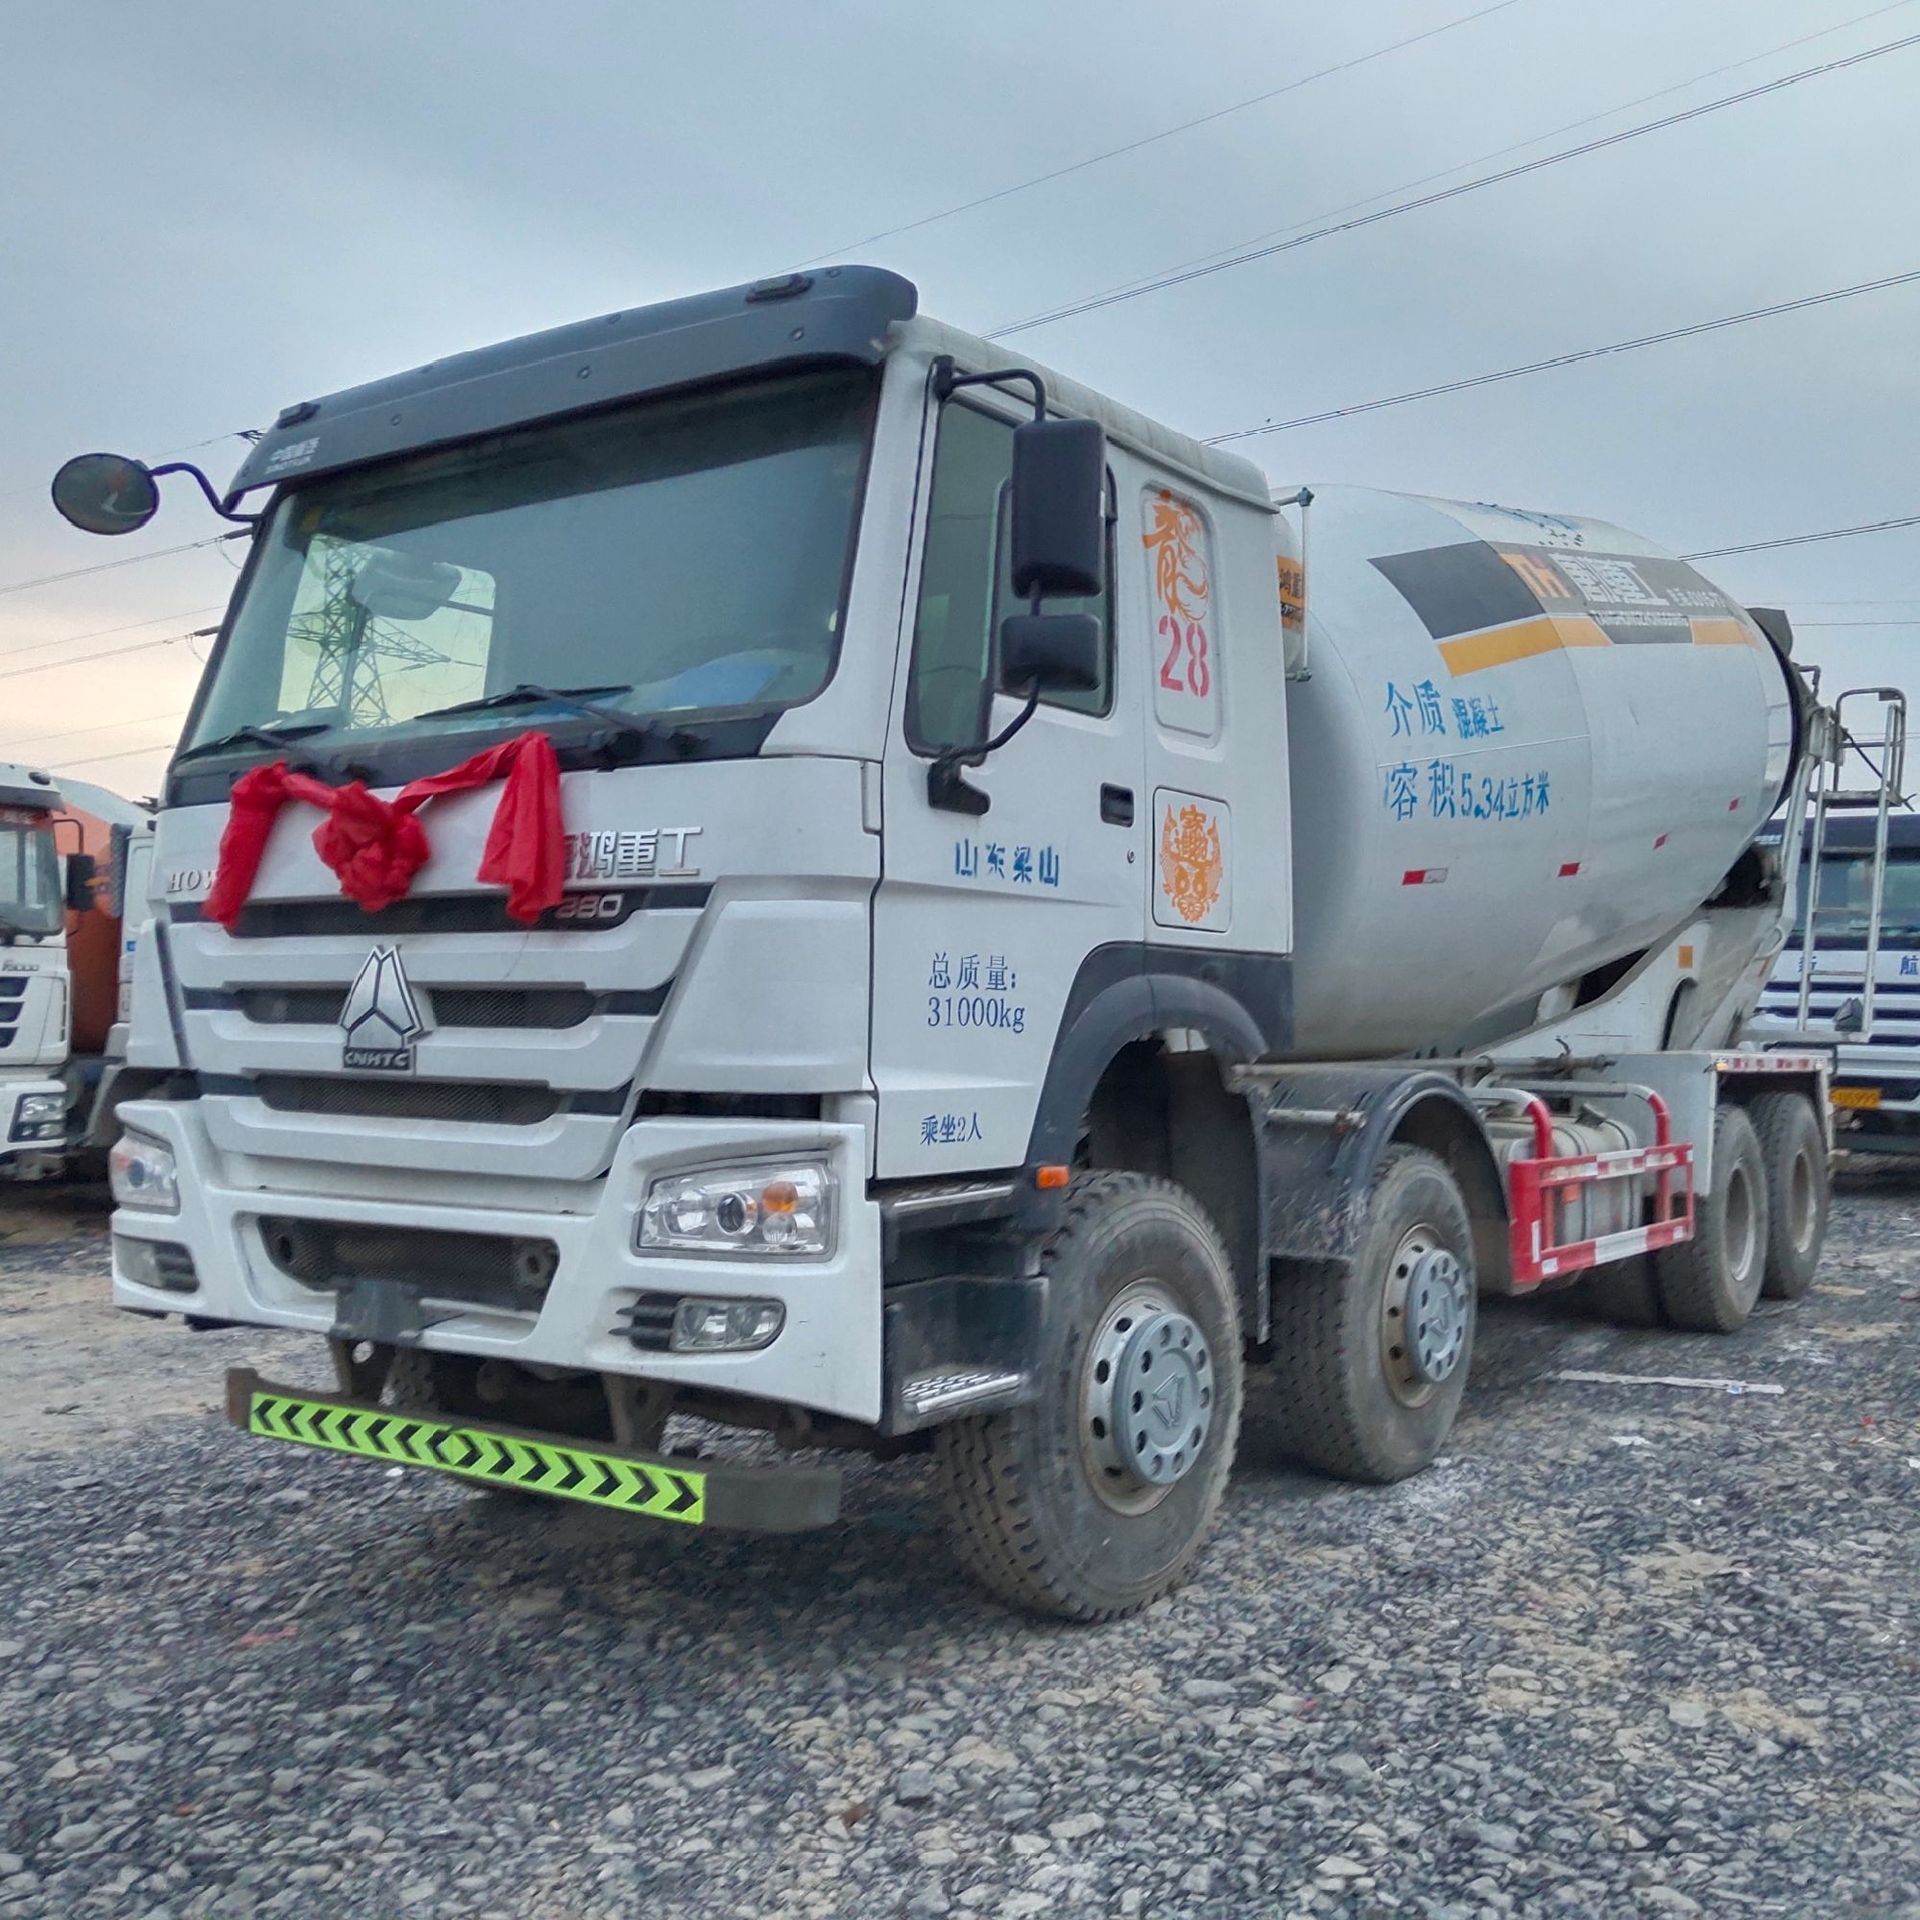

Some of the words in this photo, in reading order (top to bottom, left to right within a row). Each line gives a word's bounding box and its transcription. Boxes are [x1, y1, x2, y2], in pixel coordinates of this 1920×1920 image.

[1158, 613, 1210, 698] 28
[1384, 680, 1446, 738] 介质
[954, 838, 1061, 888] 山东梁山
[927, 996, 1026, 1034] 31000kg
[344, 1050, 410, 1067] CNHTC
[920, 1111, 983, 1146] 乘坐2人
